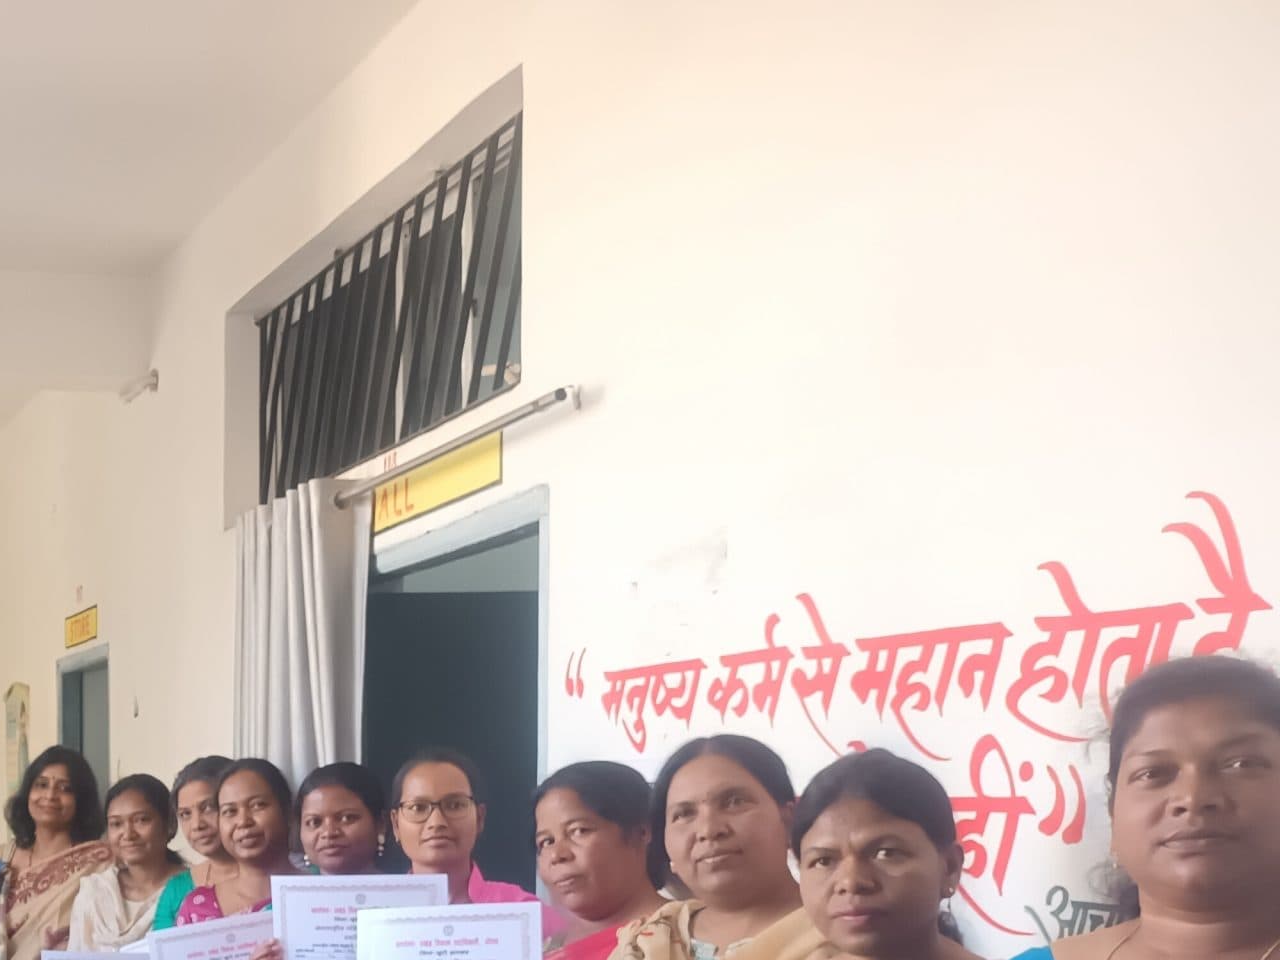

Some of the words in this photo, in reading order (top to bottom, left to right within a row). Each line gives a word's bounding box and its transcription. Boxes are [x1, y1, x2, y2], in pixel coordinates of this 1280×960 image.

[379, 477, 414, 520] ALL
[707, 613, 795, 728] कर्म
[790, 592, 851, 757] से
[849, 621, 1014, 761] महान
[1005, 561, 1195, 742] होता
